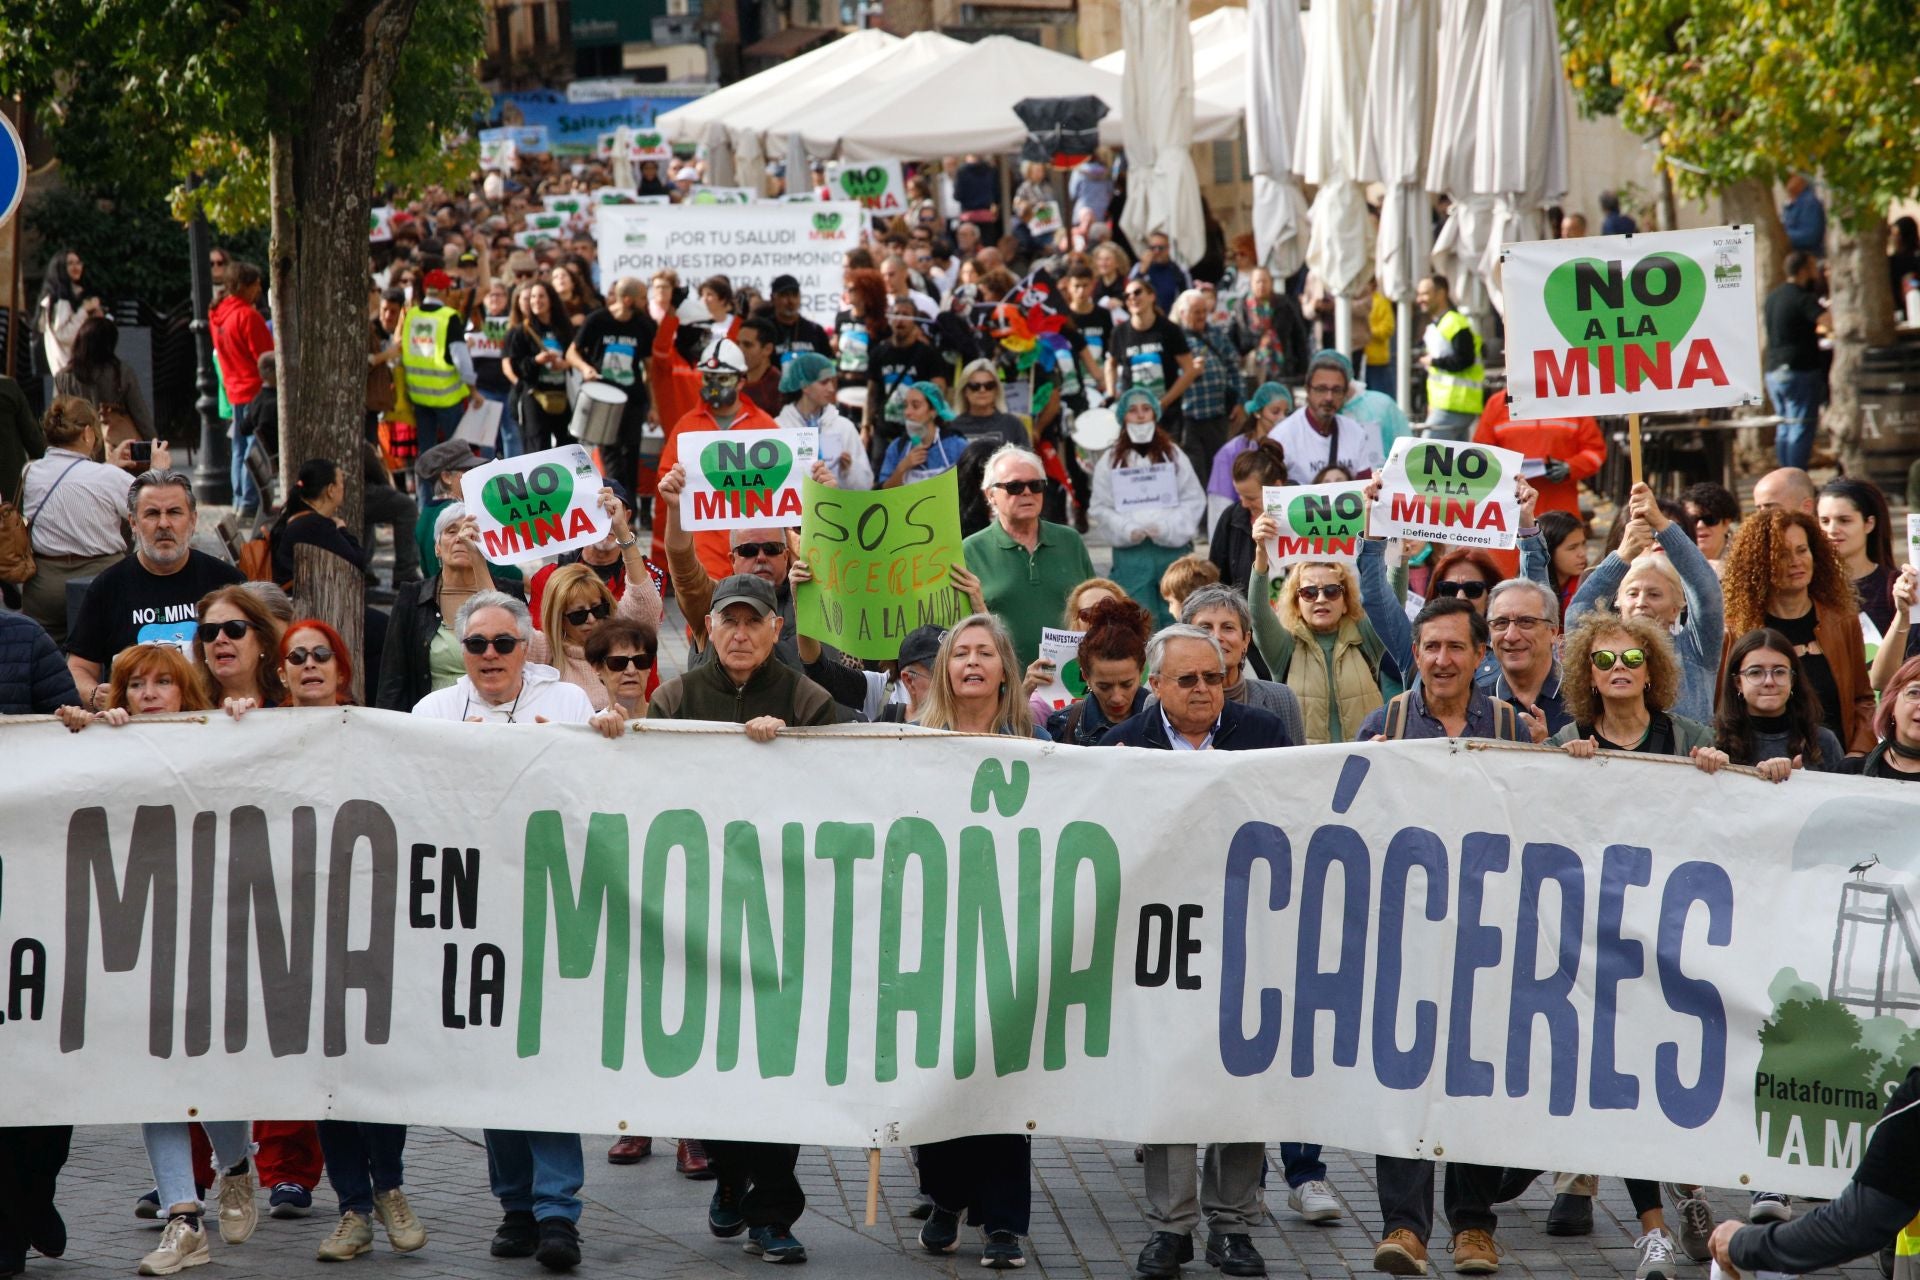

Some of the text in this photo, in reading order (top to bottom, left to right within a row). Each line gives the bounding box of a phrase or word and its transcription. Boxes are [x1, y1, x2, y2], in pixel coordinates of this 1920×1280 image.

[847, 166, 881, 186] NO
[665, 230, 705, 250] ¡POR
[709, 230, 731, 246] TU
[613, 254, 653, 273] ¡POR
[657, 253, 737, 269] NUESTRO
[1574, 256, 1682, 311] NO
[1583, 315, 1658, 340] A LA
[1533, 338, 1731, 399] MINA
[718, 440, 779, 471] NO
[1423, 445, 1488, 479] NO
[495, 466, 559, 506] NO
[722, 474, 766, 487] A LA
[1424, 479, 1470, 496] A LA
[509, 500, 552, 522] A LA
[693, 488, 802, 520] MINA
[1303, 492, 1363, 523] NO
[1391, 492, 1507, 532] MINA
[483, 507, 597, 558] MINA
[1308, 524, 1350, 536] A LA
[1402, 528, 1448, 540] ¡Defiende
[1450, 533, 1491, 545] Cáceres!
[1278, 535, 1357, 559] MIN
[806, 546, 950, 596] CÁCERES
[132, 607, 156, 624] NO
[164, 603, 199, 622] MIN
[820, 586, 962, 641] NO A LA MINA
[0, 754, 1734, 1129] A MINA EN LA MONTAÑA DE CÁCERES
[1755, 1071, 1878, 1110] Plataforma
